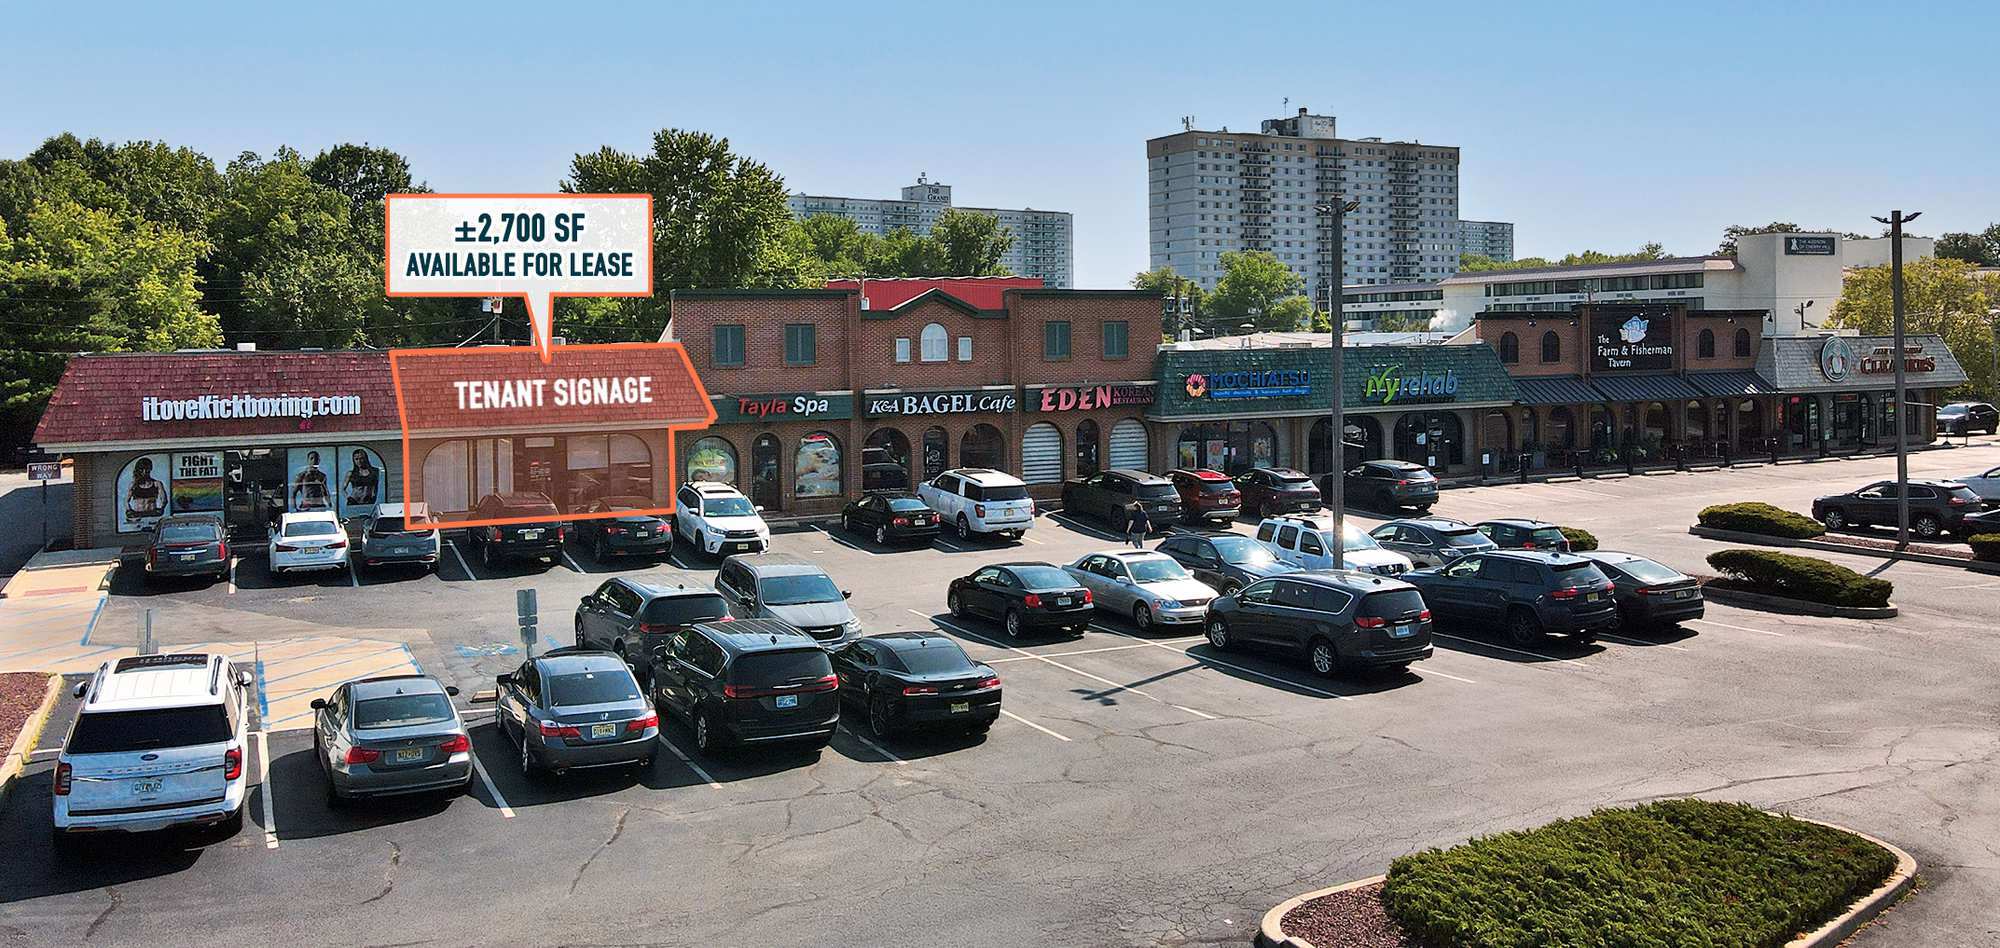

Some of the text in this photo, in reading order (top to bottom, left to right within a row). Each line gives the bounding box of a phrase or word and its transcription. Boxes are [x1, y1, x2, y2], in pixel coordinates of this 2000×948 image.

[1598, 334, 1610, 344] The
[1597, 343, 1673, 357] Farm & Fisherman
[1608, 358, 1632, 368] Tavern
[1040, 384, 1154, 412] EDEN KOREAN
[1113, 397, 1154, 405] RESTAURANT
[142, 393, 361, 421] iLoveKickboxing.com
[738, 396, 829, 417] Tayla Spa
[870, 394, 1016, 415] K&A BAGEL Cafe
[182, 455, 215, 467] FIGHT
[31, 464, 58, 472] WRONG
[179, 467, 198, 477] THE
